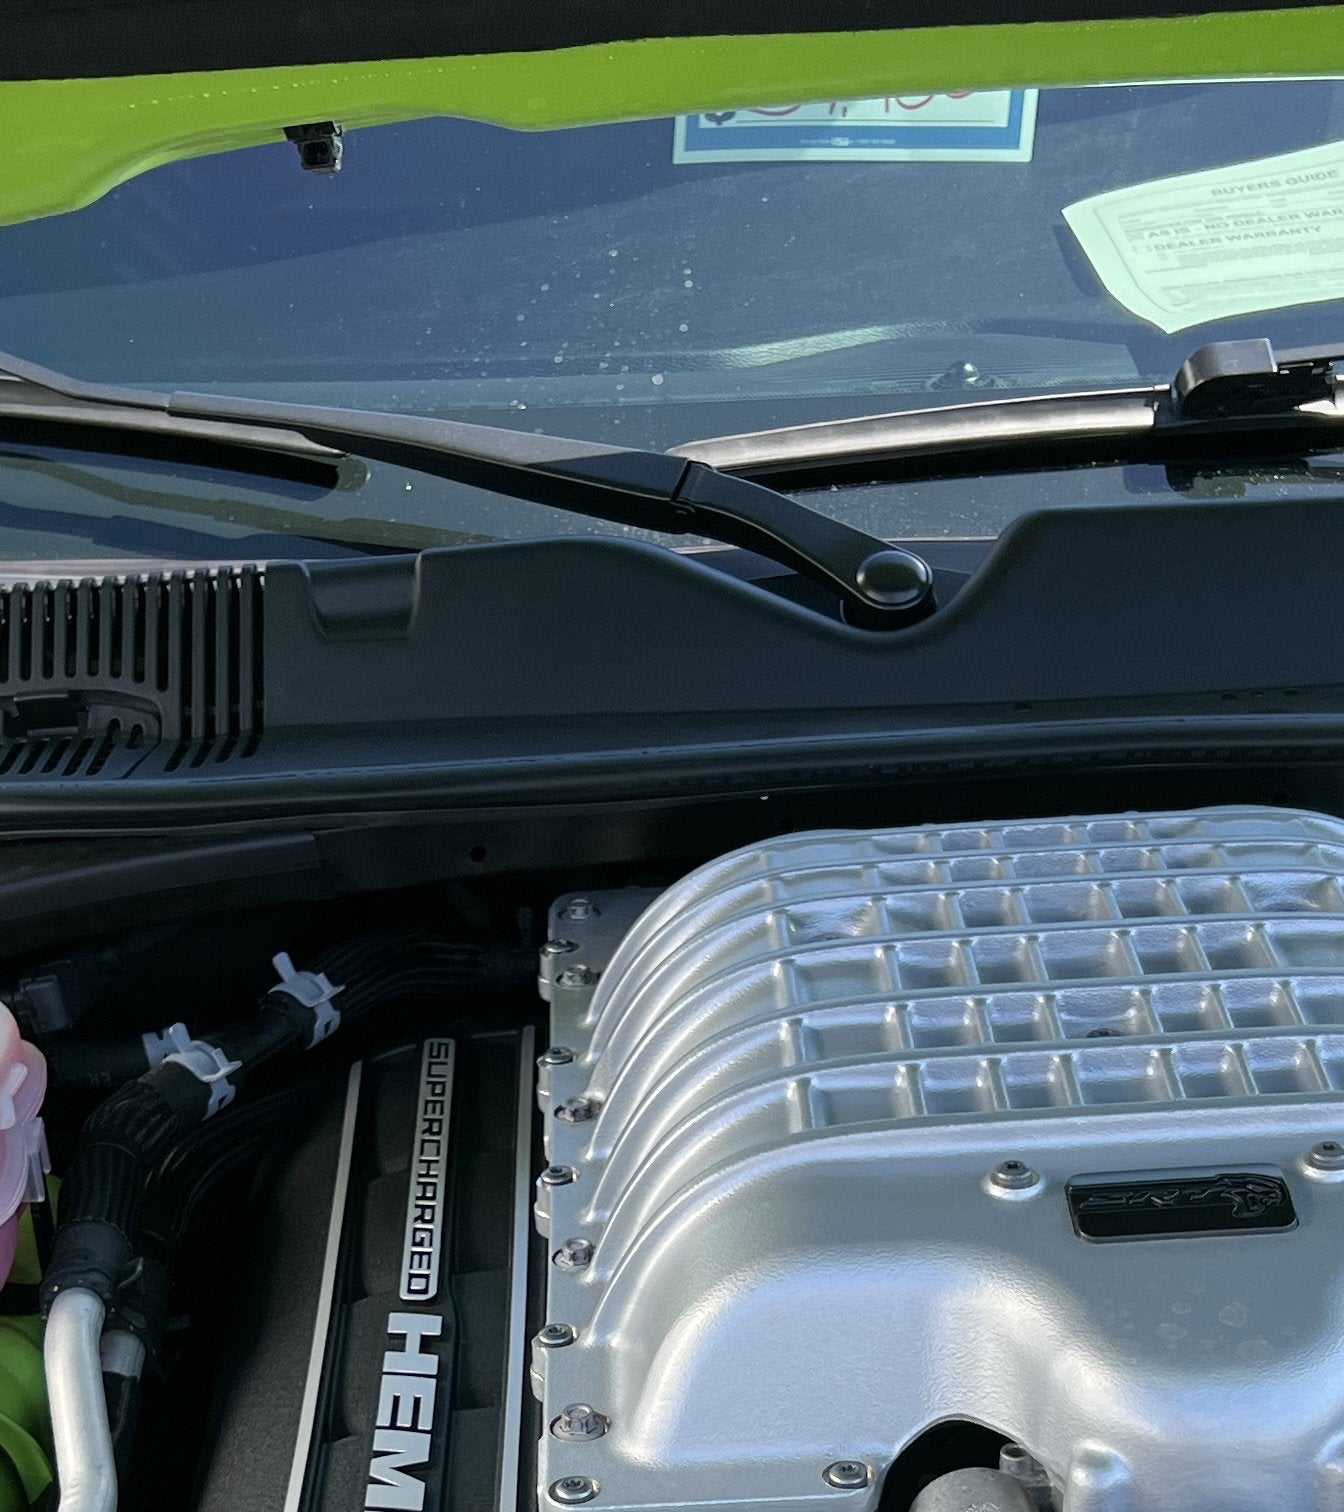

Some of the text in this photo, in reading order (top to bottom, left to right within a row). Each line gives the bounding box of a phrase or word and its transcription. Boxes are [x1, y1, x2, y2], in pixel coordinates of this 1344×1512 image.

[1211, 168, 1340, 197] BUYERS GUIDE
[1232, 211, 1302, 228] DEALER
[1152, 224, 1324, 252] DEALER WARRANTY
[406, 1040, 451, 1297] SUPERCHARGED
[1080, 1187, 1222, 1209] SRT
